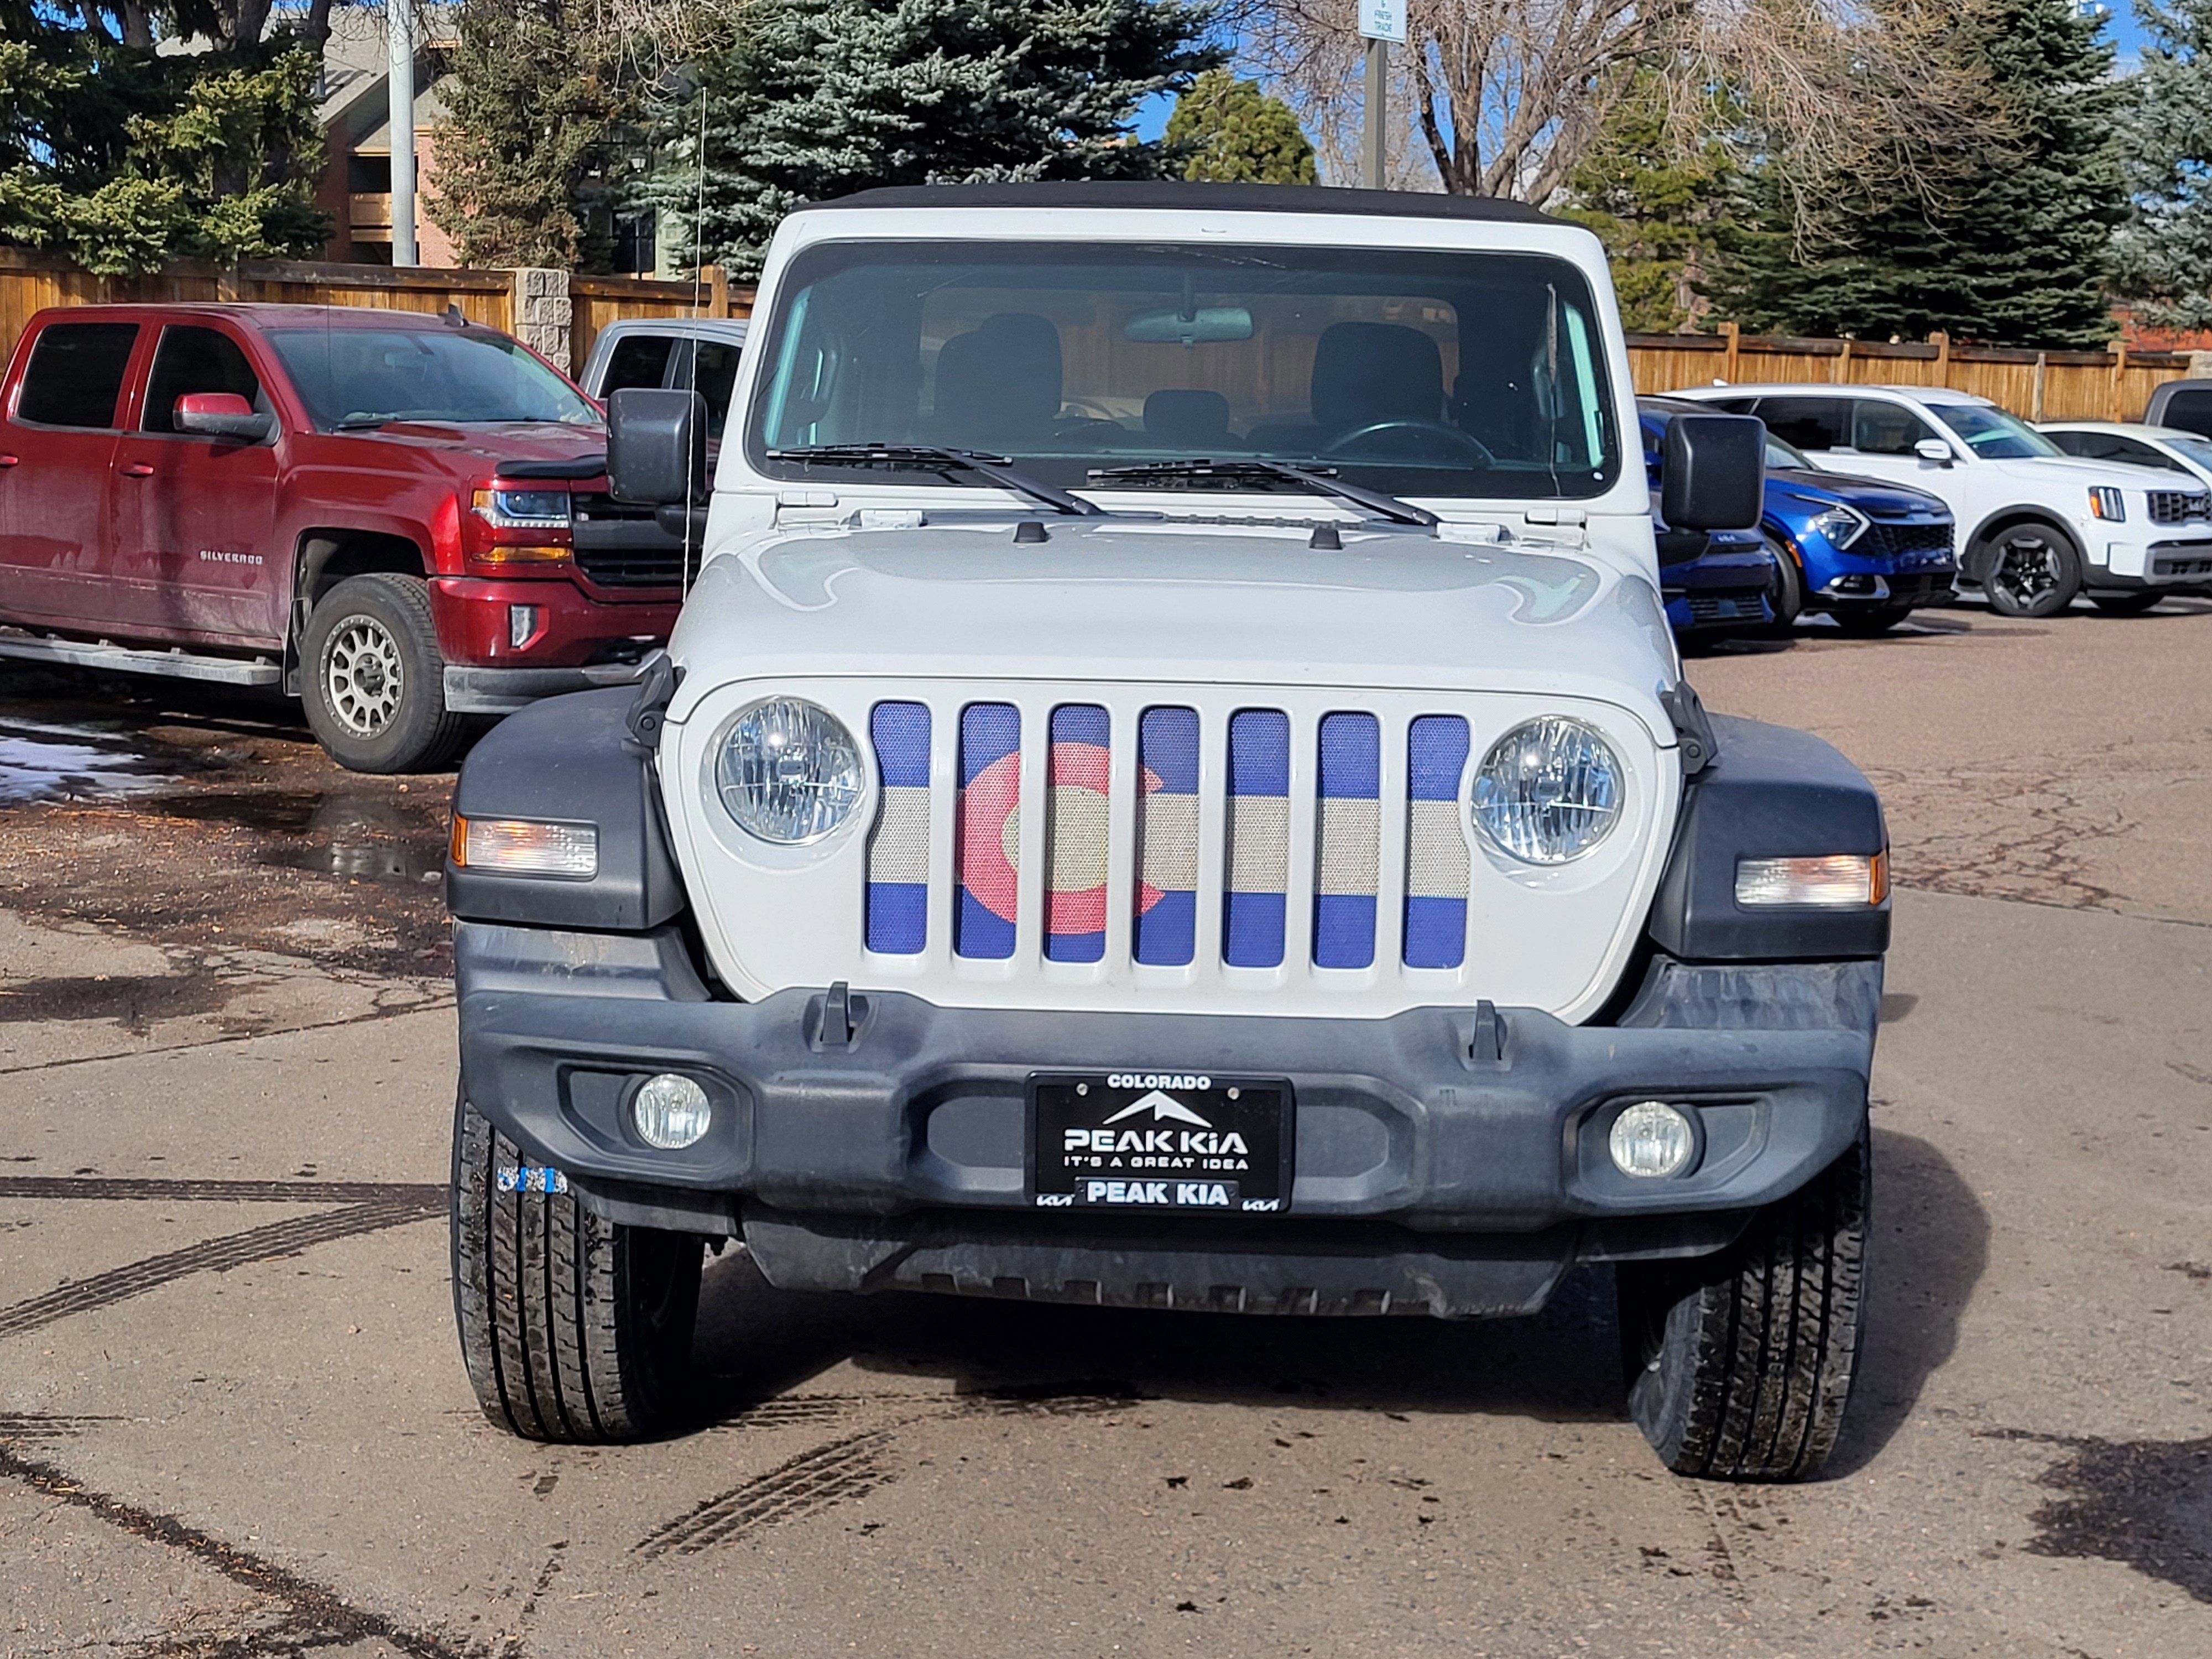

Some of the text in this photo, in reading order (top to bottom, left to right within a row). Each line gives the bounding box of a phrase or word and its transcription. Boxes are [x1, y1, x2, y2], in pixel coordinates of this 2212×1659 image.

[200, 550, 263, 565] SILVERADO
[1107, 1074, 1212, 1090] COLORADO
[1064, 1129, 1175, 1152] PEAK
[1064, 1156, 1249, 1170] IT'S A GREAT IDEA
[1087, 1181, 1229, 1206] PEAK KIA
